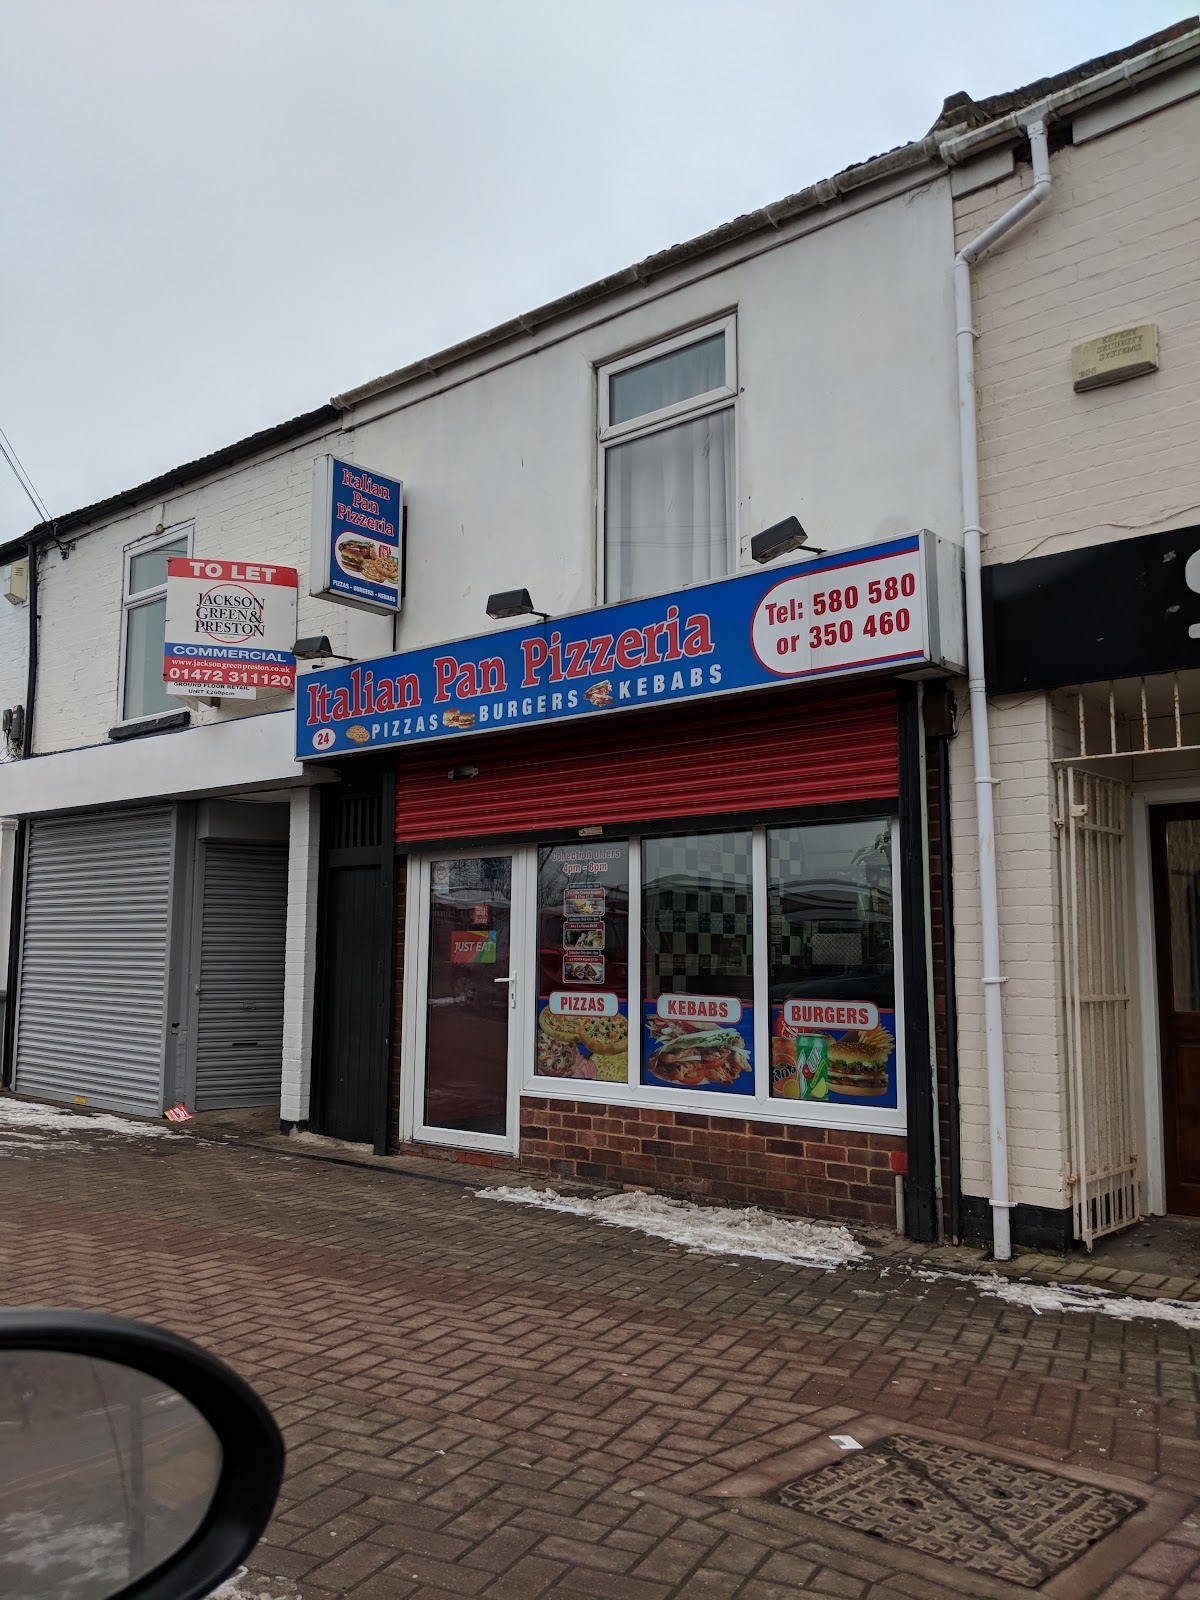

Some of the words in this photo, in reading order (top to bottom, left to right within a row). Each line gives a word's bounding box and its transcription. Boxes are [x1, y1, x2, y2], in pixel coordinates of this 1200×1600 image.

[1096, 335, 1143, 354] SECURITY
[1098, 344, 1142, 361] SYSTEMS
[342, 468, 390, 500] Italian
[352, 491, 379, 515] Pan
[337, 502, 394, 536] Pizzeria
[189, 561, 223, 578] TO
[231, 565, 276, 582] LET
[333, 580, 349, 589] PIZZAS
[353, 586, 374, 596] BURGERS
[378, 592, 396, 602] KEBABS
[765, 599, 803, 626] Tel:
[813, 586, 858, 616] 580
[868, 572, 915, 604] 580
[196, 593, 265, 610] JACKSON
[195, 620, 265, 637] PRESTON
[776, 634, 800, 655] or
[809, 620, 853, 649] 350
[863, 608, 910, 638] 460
[173, 646, 286, 662] COMMERCIAL
[172, 659, 290, 673] www.jacksongreenpreston.co.uk
[307, 667, 421, 726] Italian
[433, 656, 507, 703] Pan
[521, 605, 715, 688] Pizzeria
[169, 668, 223, 682] 01472
[228, 671, 291, 687] 311120
[317, 732, 330, 746] 24
[371, 713, 438, 740] PIZZAS
[479, 689, 579, 722] BURGERS
[619, 663, 722, 699] KEBABS
[593, 848, 620, 859] Offers
[562, 862, 581, 875] 4pm
[588, 861, 608, 874] 8pm
[454, 942, 475, 953] JUST
[476, 942, 493, 952] EAT
[561, 996, 605, 1012] PIZZAS
[667, 1000, 728, 1018] KEBABS
[791, 1005, 869, 1024] BURGERS
[770, 1063, 796, 1081] anta
